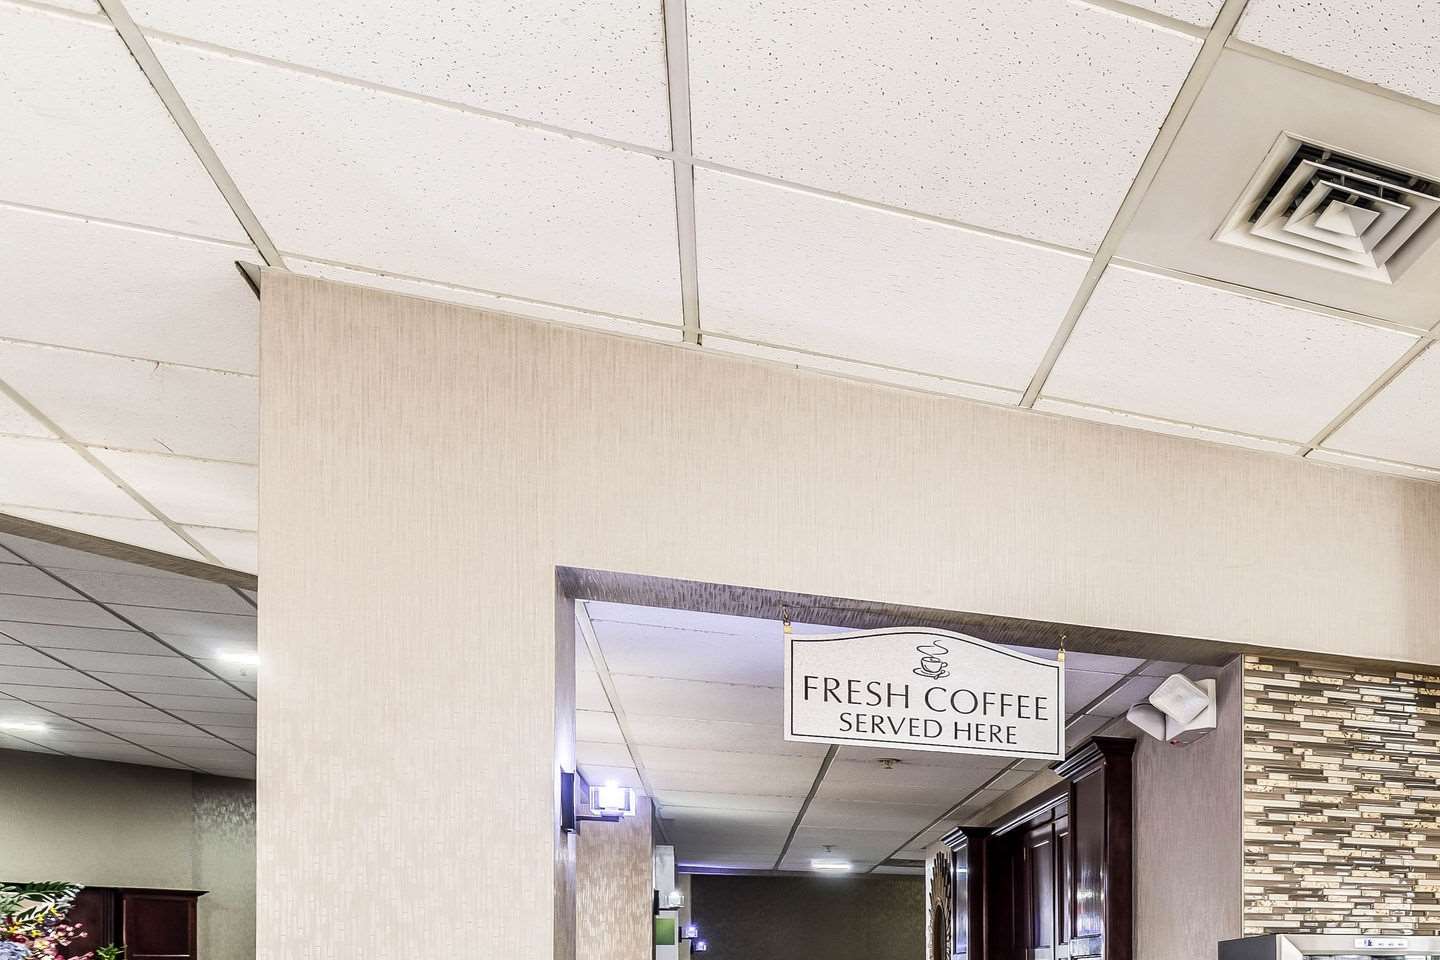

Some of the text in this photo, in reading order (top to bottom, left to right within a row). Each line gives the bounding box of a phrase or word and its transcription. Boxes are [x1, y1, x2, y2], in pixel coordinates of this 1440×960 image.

[803, 675, 1049, 721] FRESH COFFEE
[839, 712, 1018, 745] SERVED HERE
